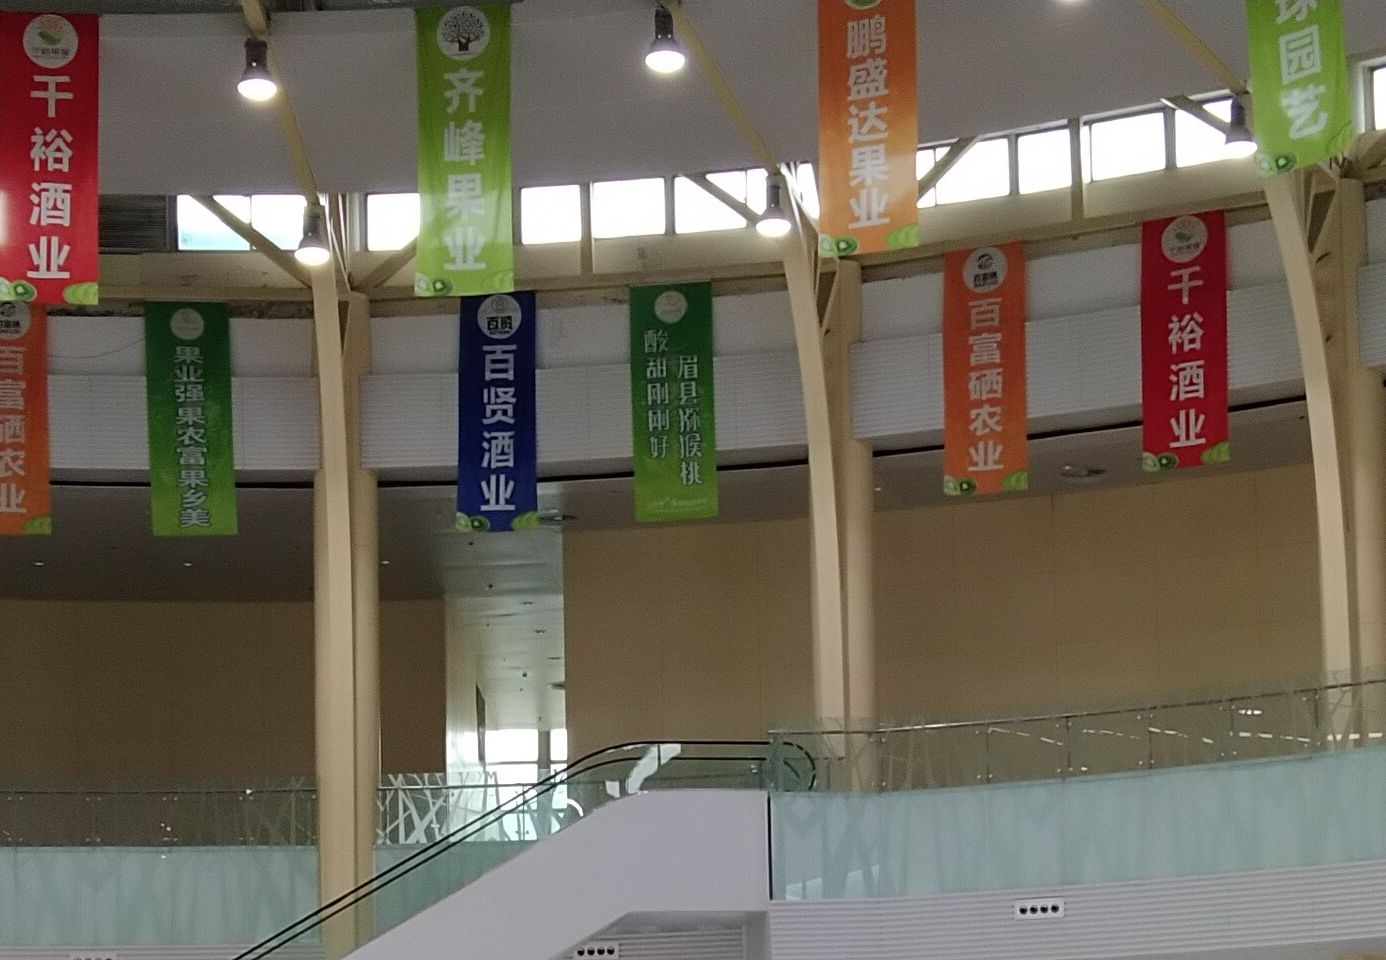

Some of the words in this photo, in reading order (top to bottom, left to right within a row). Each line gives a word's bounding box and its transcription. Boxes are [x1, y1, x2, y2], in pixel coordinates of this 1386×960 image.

[443, 68, 486, 271] 齐峰果业
[846, 14, 890, 230] 鹏盛达果业
[174, 347, 212, 528] 果业强果农富果乡美
[480, 344, 517, 511] 百贤酒业
[644, 330, 670, 460] 酸甜刚刚好
[677, 355, 703, 486] 眉县猕猴桃
[967, 297, 1004, 472] 百富硒农业
